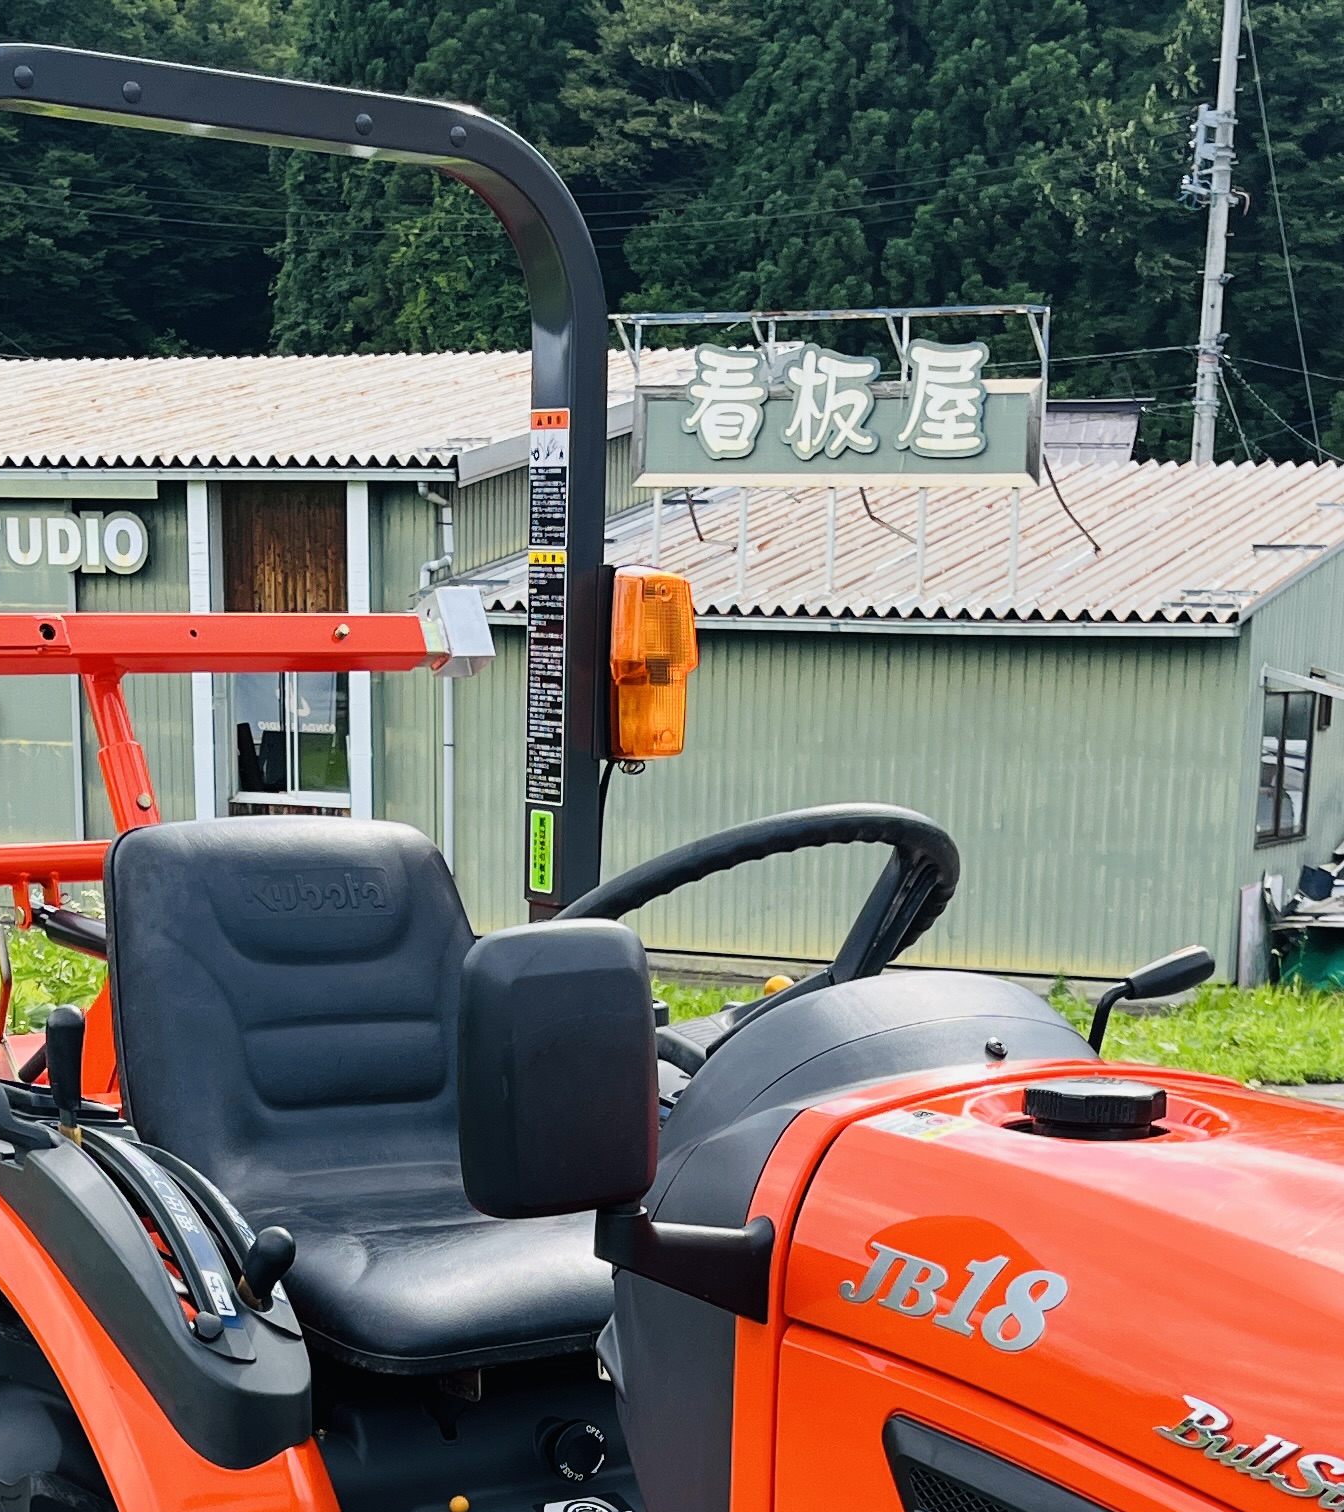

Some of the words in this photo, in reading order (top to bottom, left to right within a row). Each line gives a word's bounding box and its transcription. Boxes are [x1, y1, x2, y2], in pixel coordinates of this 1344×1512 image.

[684, 345, 986, 454] 看板屋
[242, 872, 387, 913] Kubota
[839, 1241, 1069, 1353] JB18
[586, 1424, 605, 1443] OPEN
[559, 1461, 584, 1482] CLOSE
